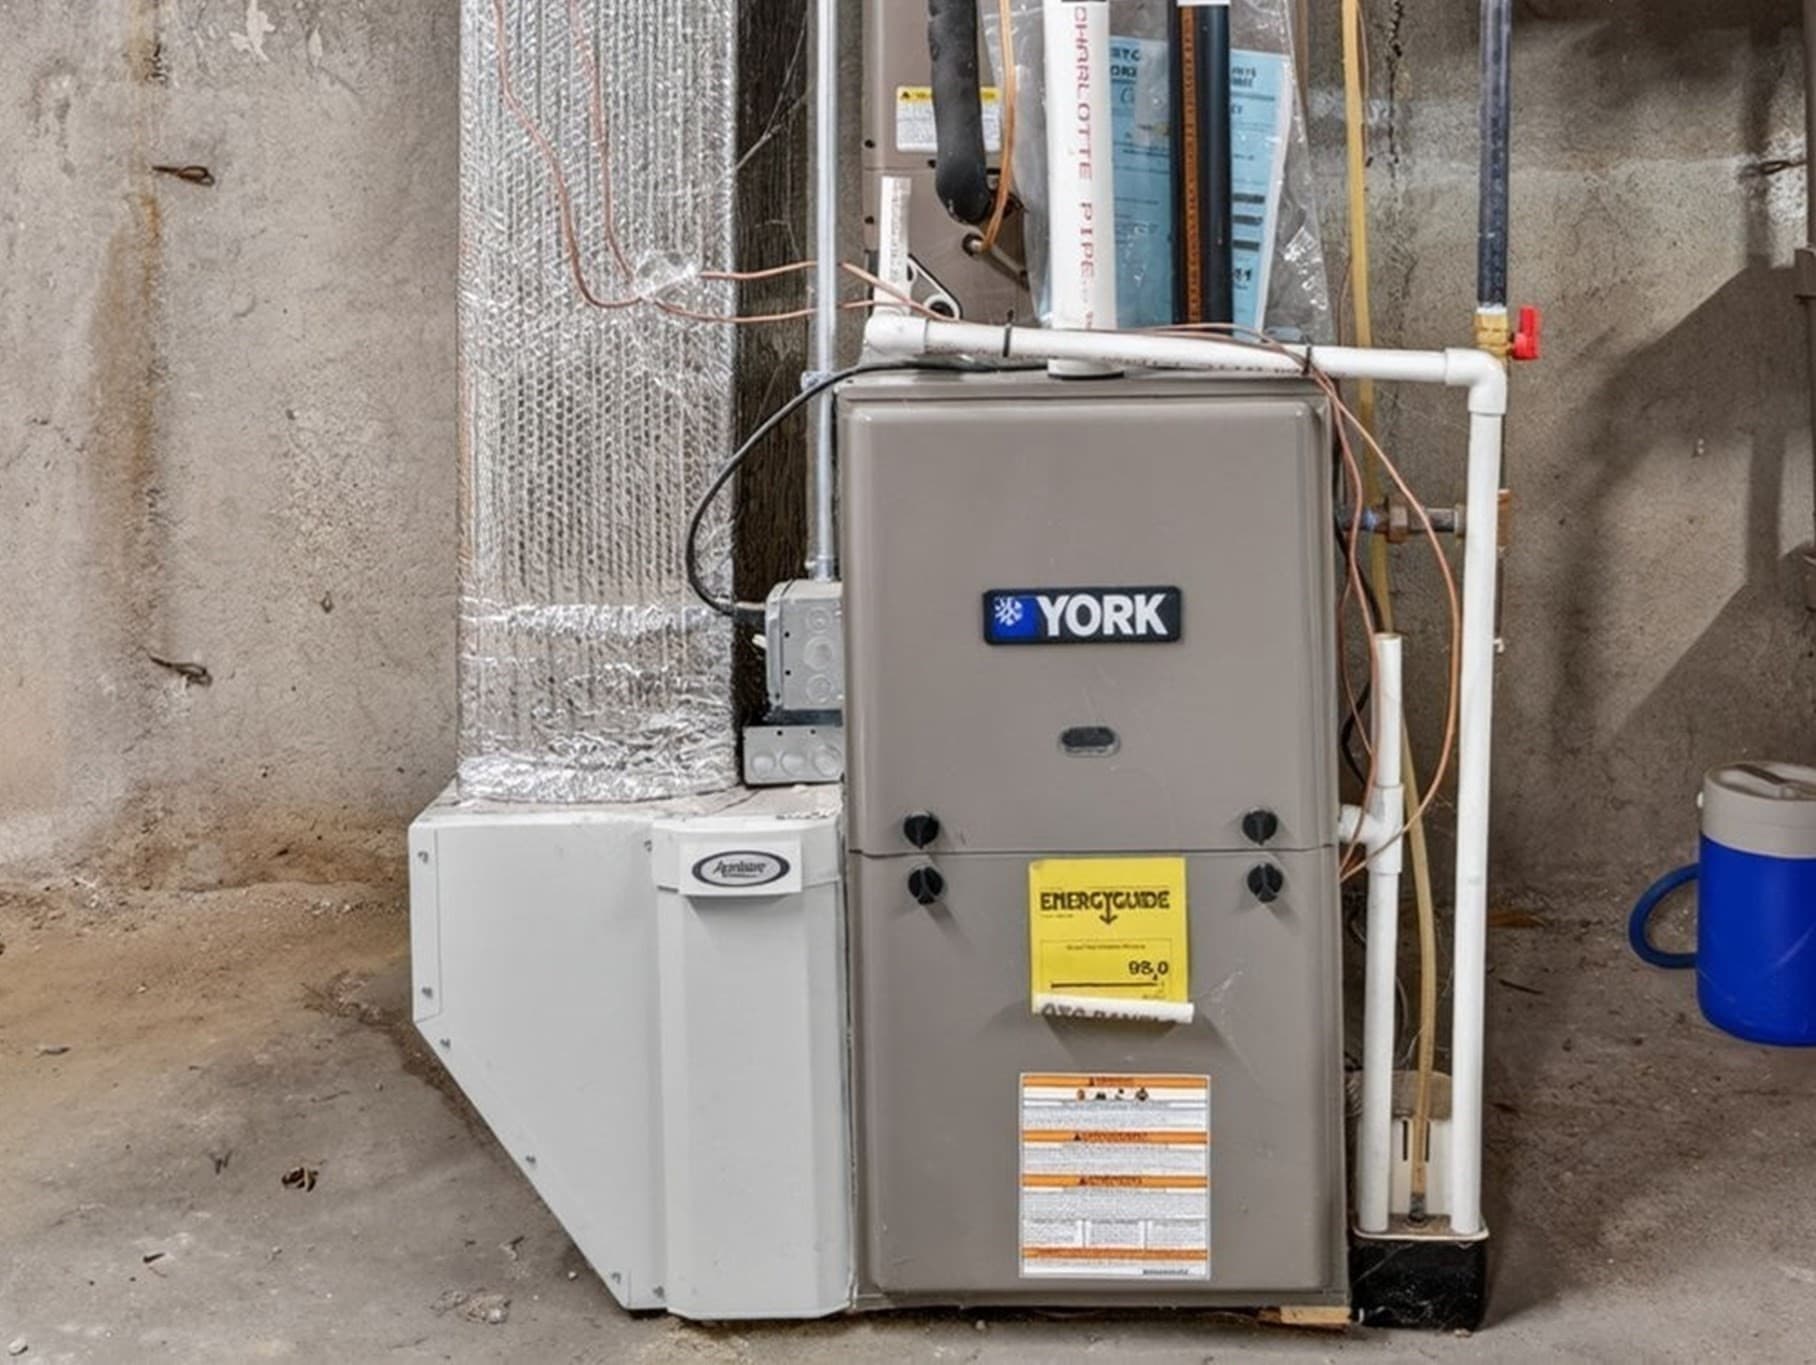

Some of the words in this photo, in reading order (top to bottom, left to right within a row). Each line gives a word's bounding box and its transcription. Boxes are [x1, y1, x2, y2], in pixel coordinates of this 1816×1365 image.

[1074, 6, 1093, 180] CHARLOTTE
[1080, 201, 1094, 278] PIPE
[1036, 593, 1168, 637] YORK
[1040, 890, 1170, 911] ENERGYGUIDE
